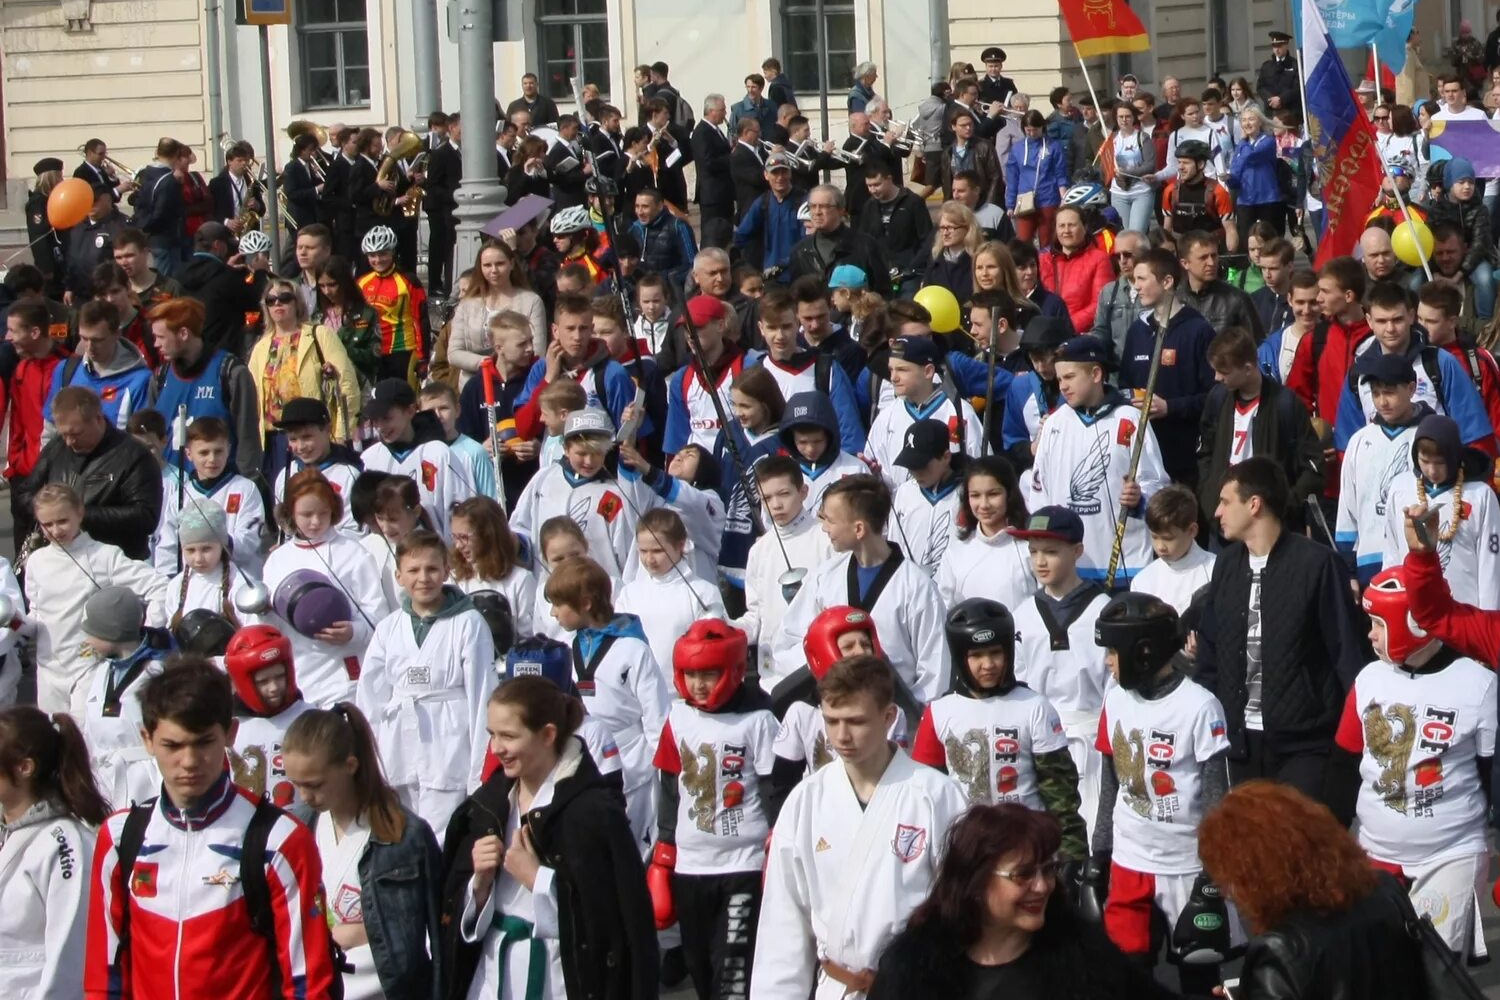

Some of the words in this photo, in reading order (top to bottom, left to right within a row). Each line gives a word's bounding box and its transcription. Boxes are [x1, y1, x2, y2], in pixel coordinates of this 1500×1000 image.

[1489, 533, 1500, 554] 8
[995, 727, 1019, 763] FCF
[1420, 707, 1456, 754] FCF
[722, 743, 747, 780] FCF
[1147, 731, 1175, 769] FCF
